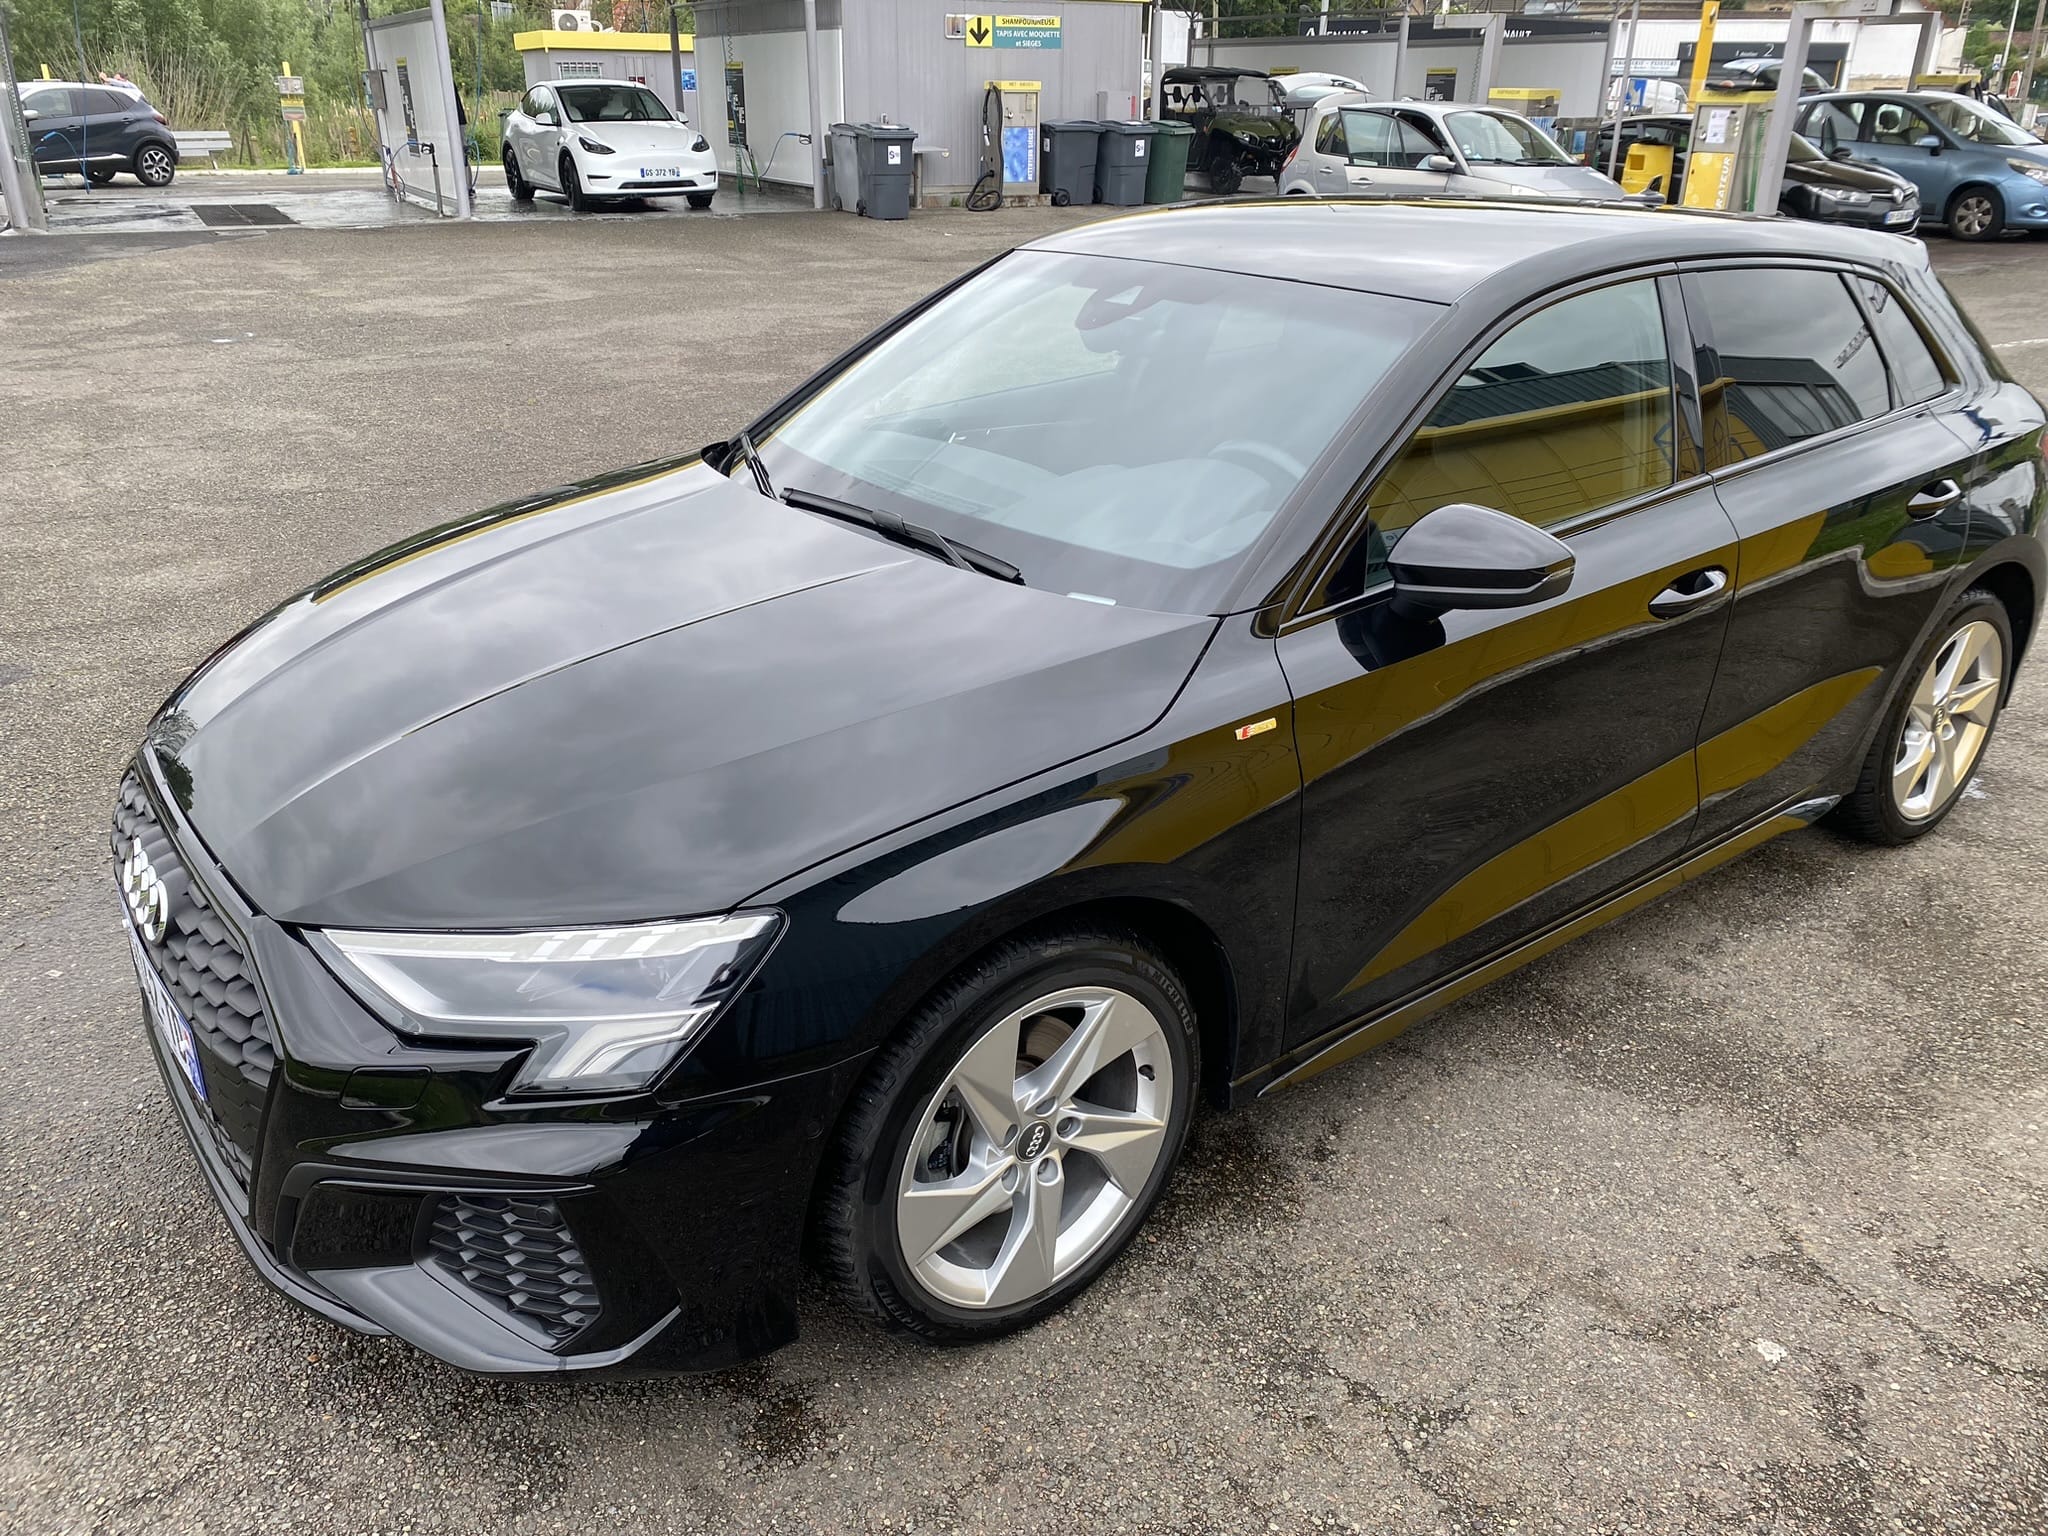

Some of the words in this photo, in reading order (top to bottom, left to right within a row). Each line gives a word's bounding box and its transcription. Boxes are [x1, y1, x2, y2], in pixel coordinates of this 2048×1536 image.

[996, 30, 1012, 38] TAPIS
[1013, 30, 1028, 38] AVEC
[1029, 31, 1060, 39] MOQUETTE
[1763, 43, 1775, 57] 2
[1715, 155, 1731, 209] RATEUR
[1152, 969, 1194, 1032] MICHELIN
